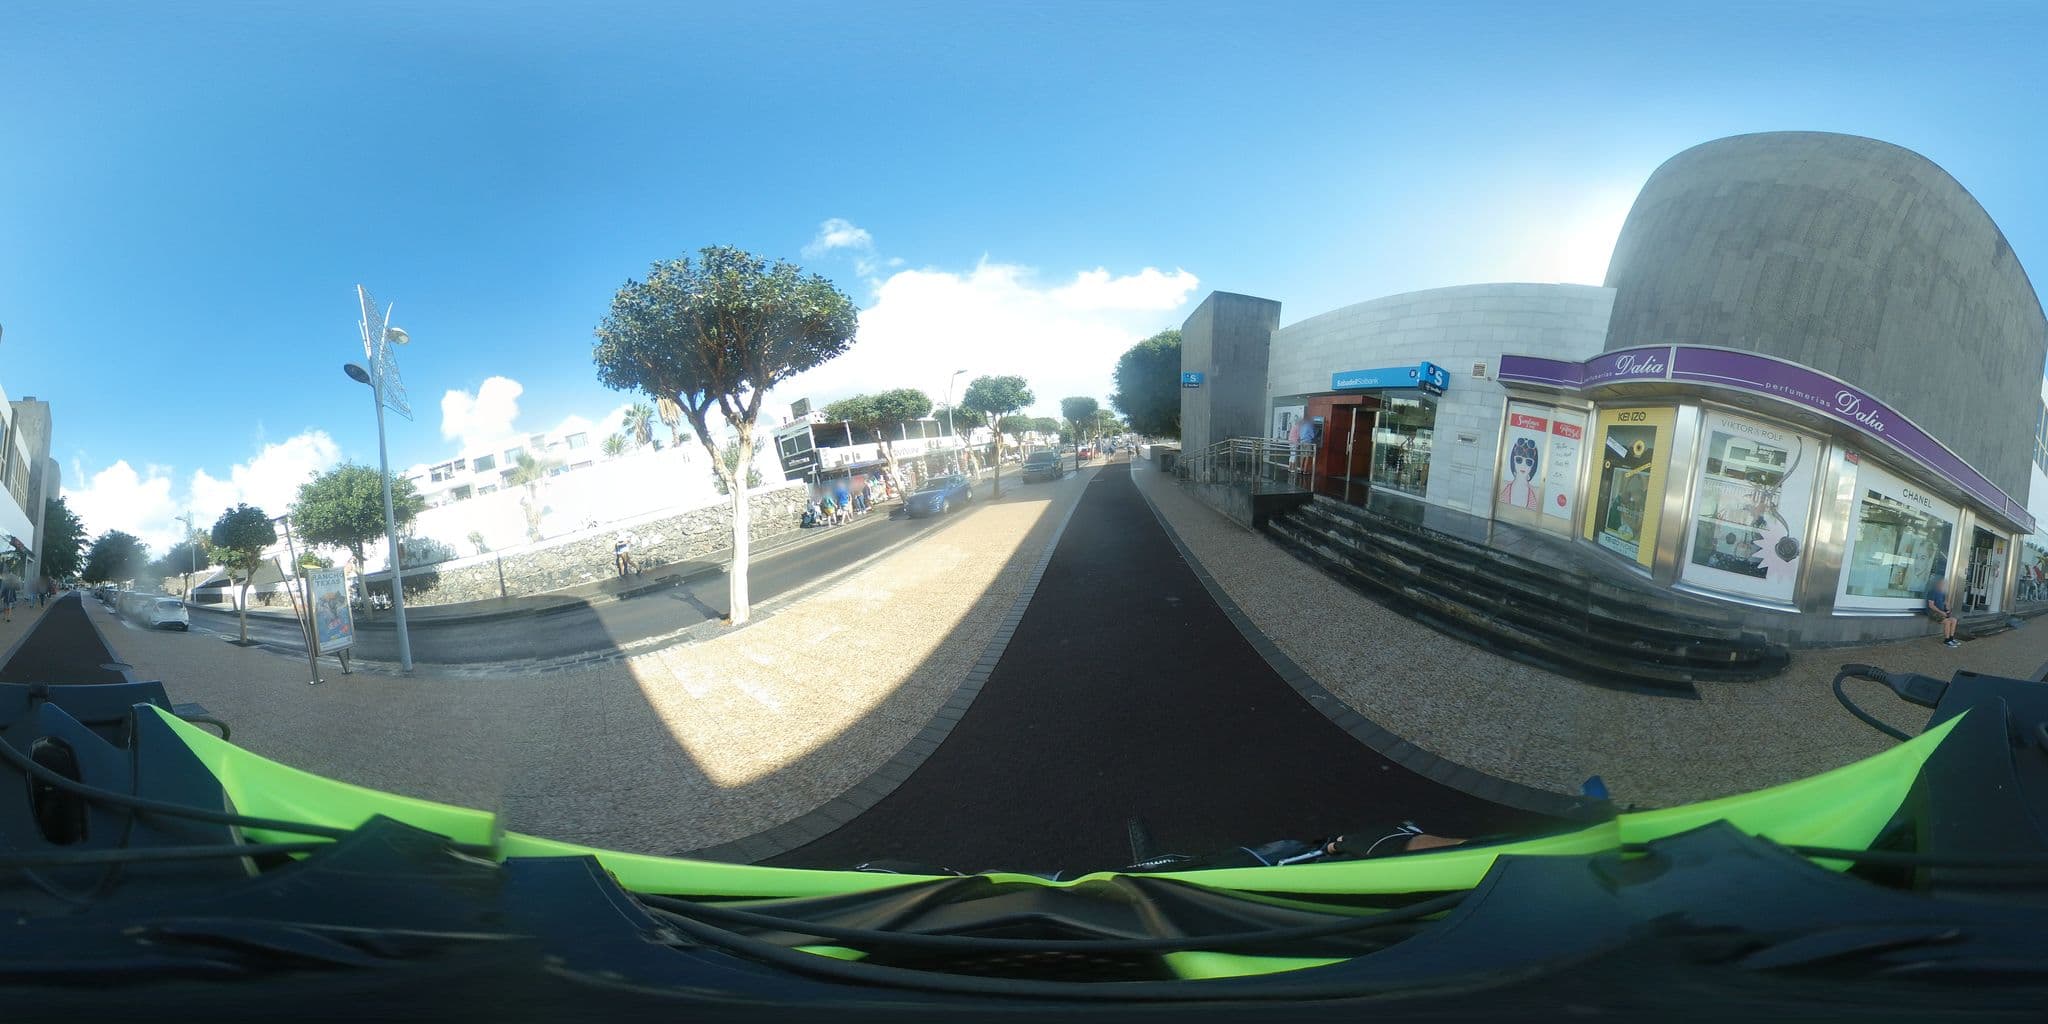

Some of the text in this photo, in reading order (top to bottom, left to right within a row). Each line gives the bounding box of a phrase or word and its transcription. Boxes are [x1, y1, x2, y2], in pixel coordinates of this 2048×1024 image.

[1615, 354, 1664, 375] Dalia
[1617, 411, 1647, 422] KENZO
[1765, 382, 1884, 432] perfumerias Dalia
[1721, 419, 1754, 434] VIKTOR
[1902, 488, 1933, 509] CHANEL
